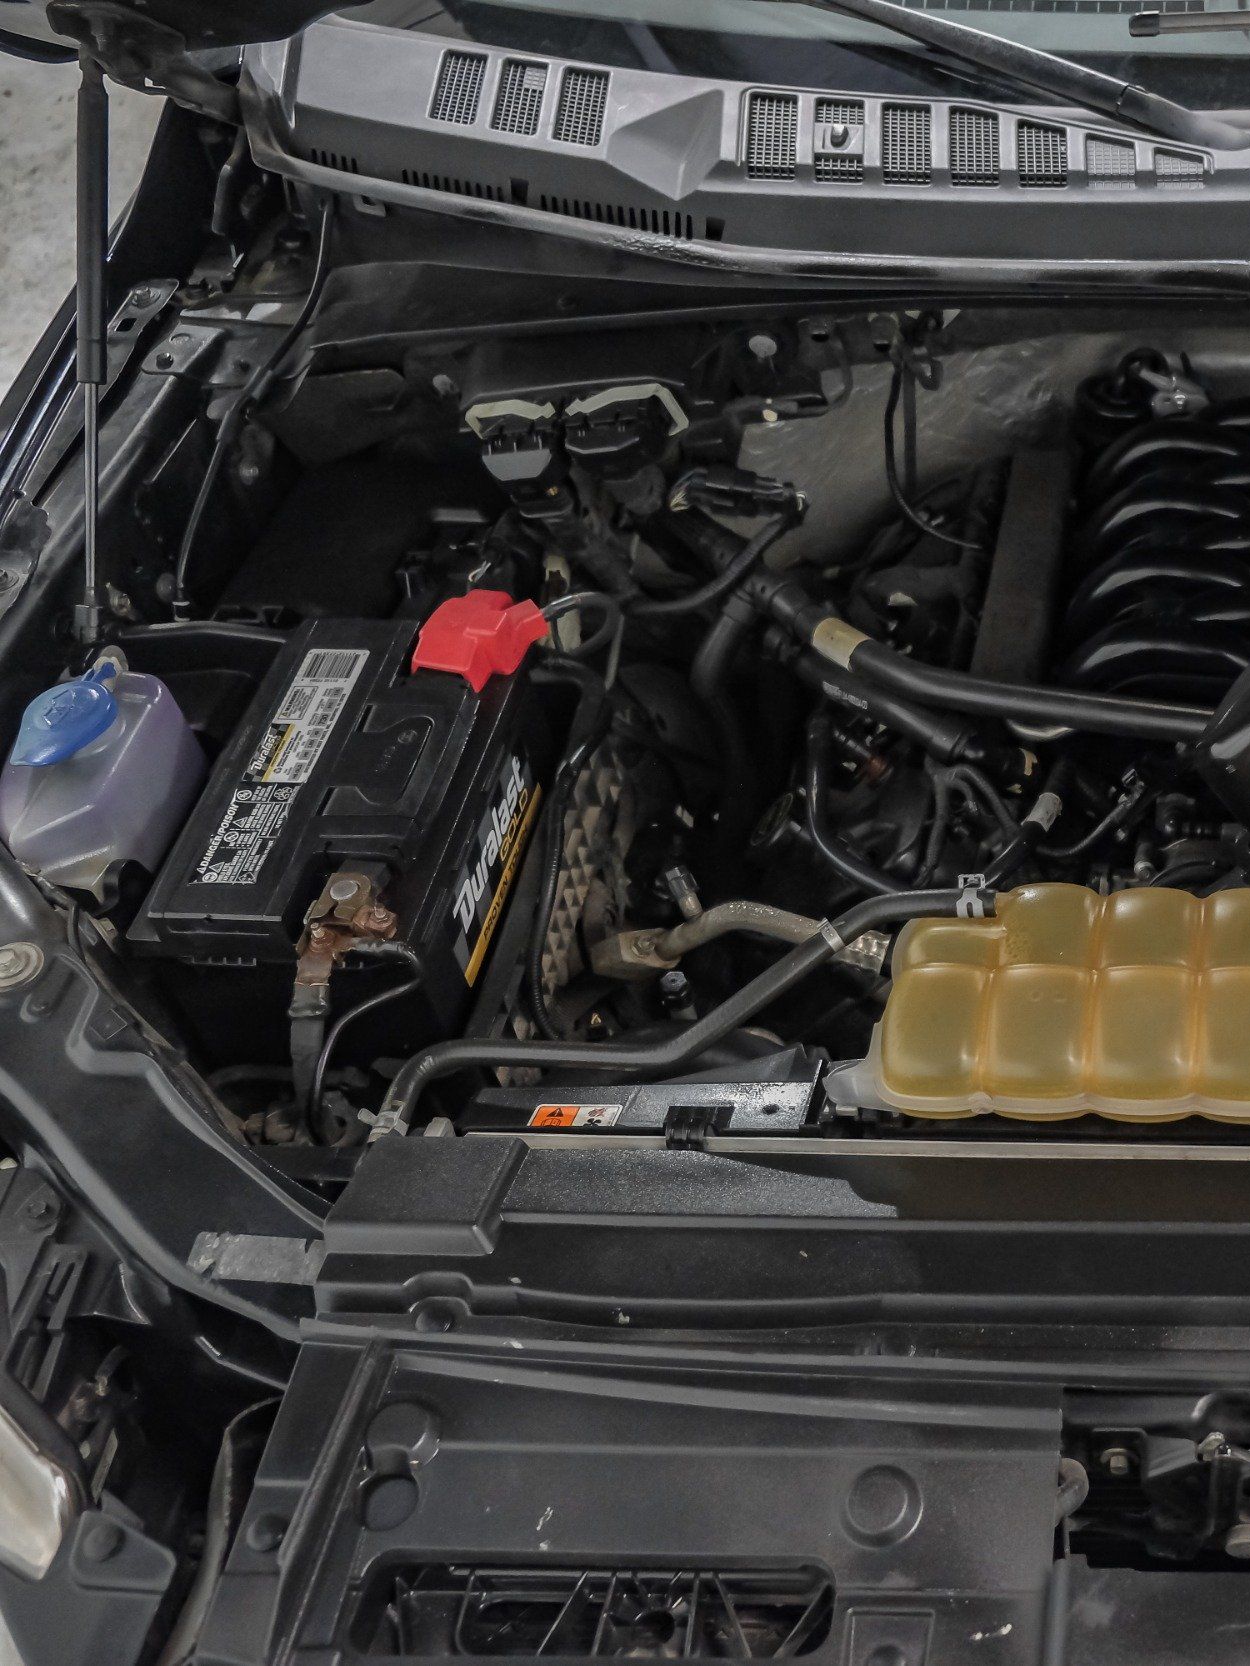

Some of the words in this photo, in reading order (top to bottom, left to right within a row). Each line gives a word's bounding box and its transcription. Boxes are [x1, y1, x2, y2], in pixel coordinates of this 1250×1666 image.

[251, 726, 278, 770] Duralast
[320, 714, 330, 726] 730
[200, 803, 240, 870] DANGER/POISON
[453, 756, 525, 934] Duralast
[500, 788, 528, 862] GOLD
